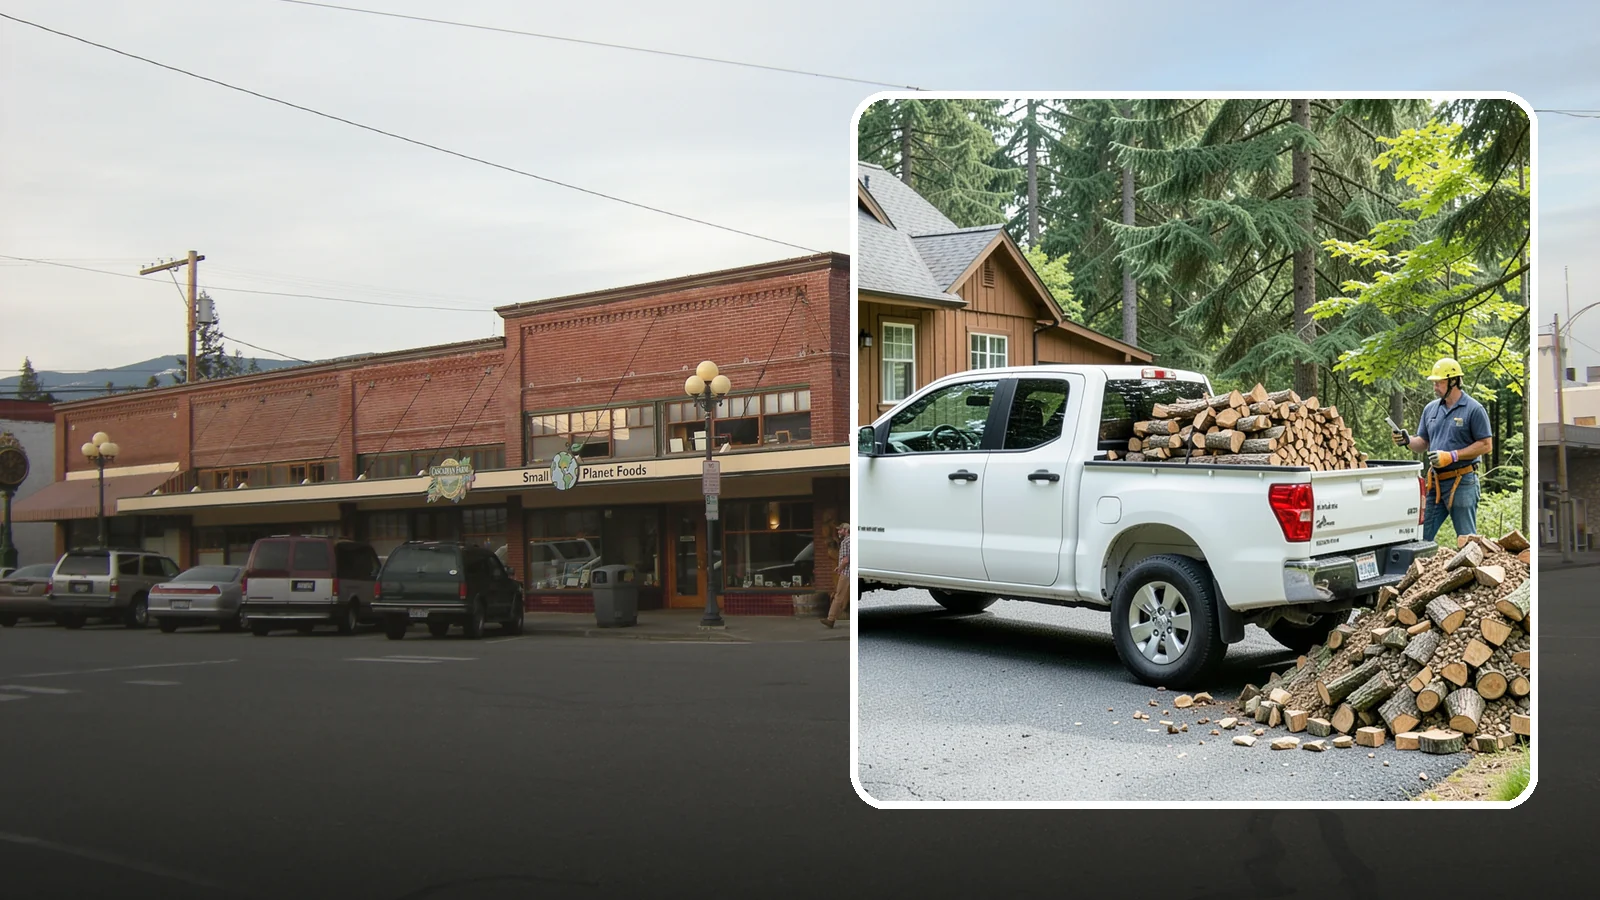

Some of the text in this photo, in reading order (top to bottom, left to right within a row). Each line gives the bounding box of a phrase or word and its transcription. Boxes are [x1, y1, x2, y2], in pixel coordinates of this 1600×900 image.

[523, 464, 647, 483] Small Planet Foods
